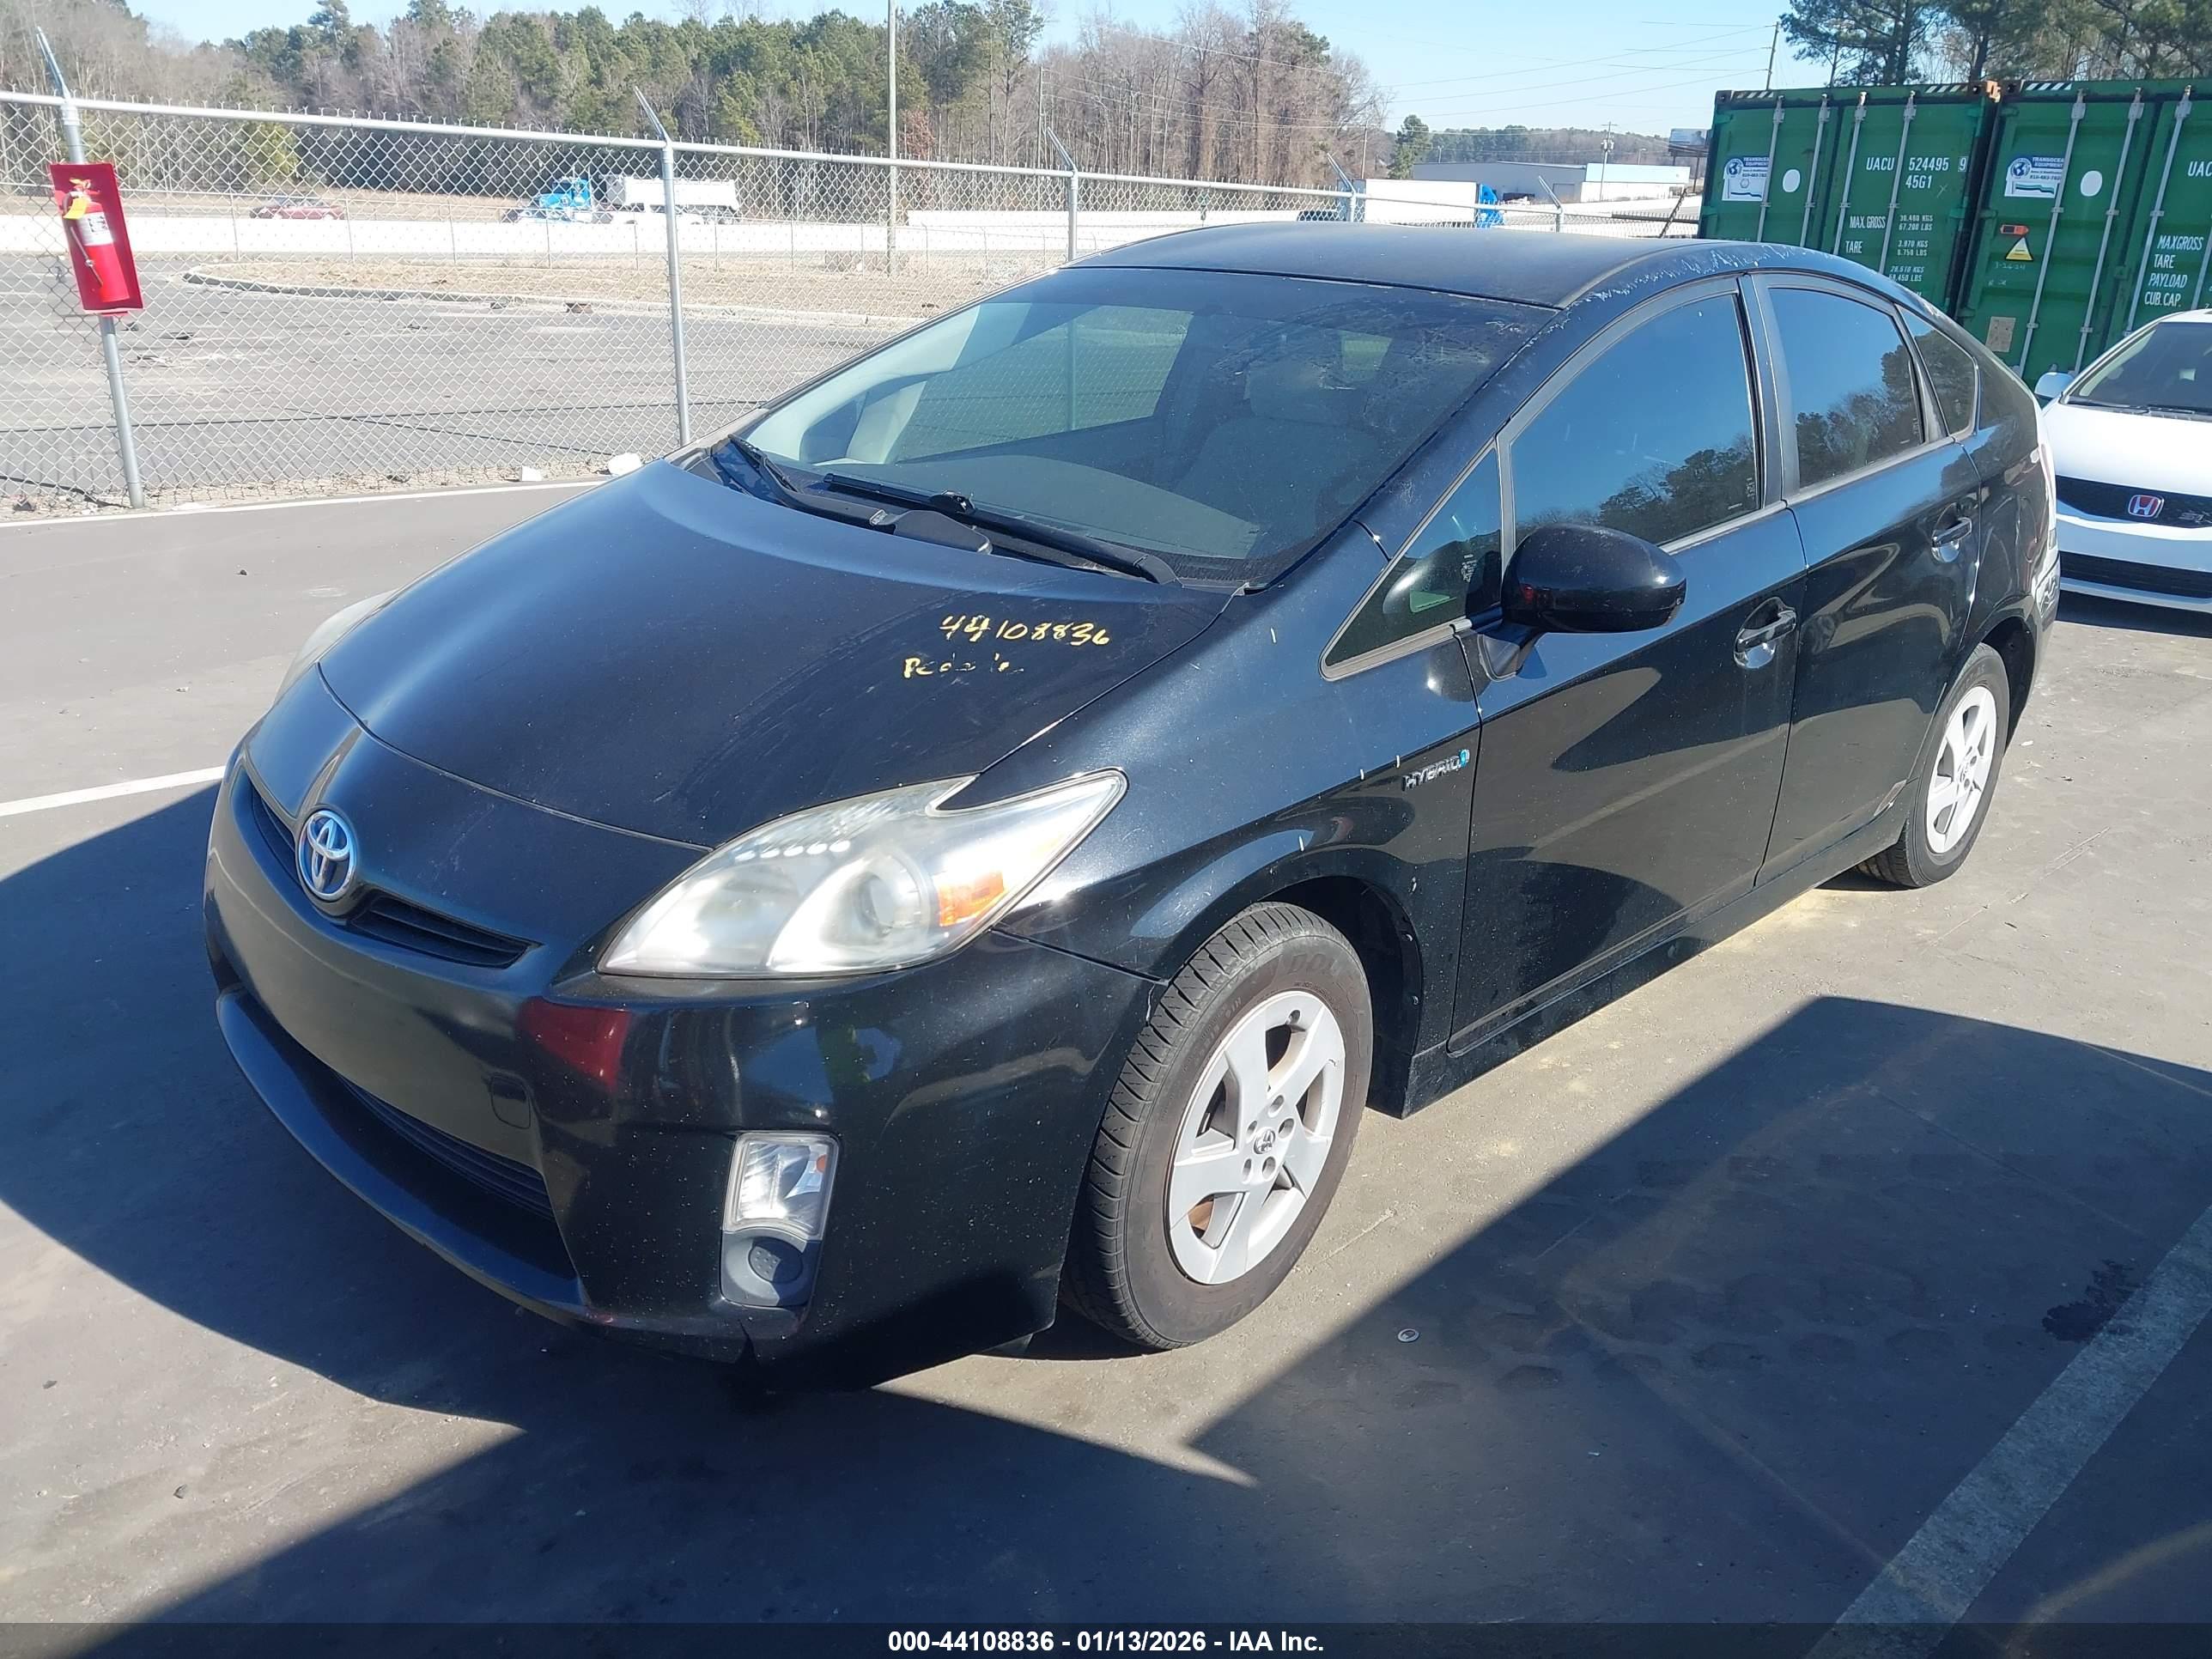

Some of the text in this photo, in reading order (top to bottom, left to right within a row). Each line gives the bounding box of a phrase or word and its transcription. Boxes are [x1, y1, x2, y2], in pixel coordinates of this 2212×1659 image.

[1866, 156, 1968, 172] UACU 524495 9
[1905, 174, 1932, 189] 45G1
[1866, 216, 1887, 228] GROSS
[1922, 214, 1934, 222] KGS
[1920, 222, 1933, 231] LBS
[1845, 240, 1863, 253] TARE
[1916, 240, 1929, 248] KGS
[2154, 254, 2176, 269] TARE
[2148, 272, 2188, 289] PAYLOAD
[939, 615, 1110, 646] 44108836
[1401, 755, 1462, 792] HYBRID
